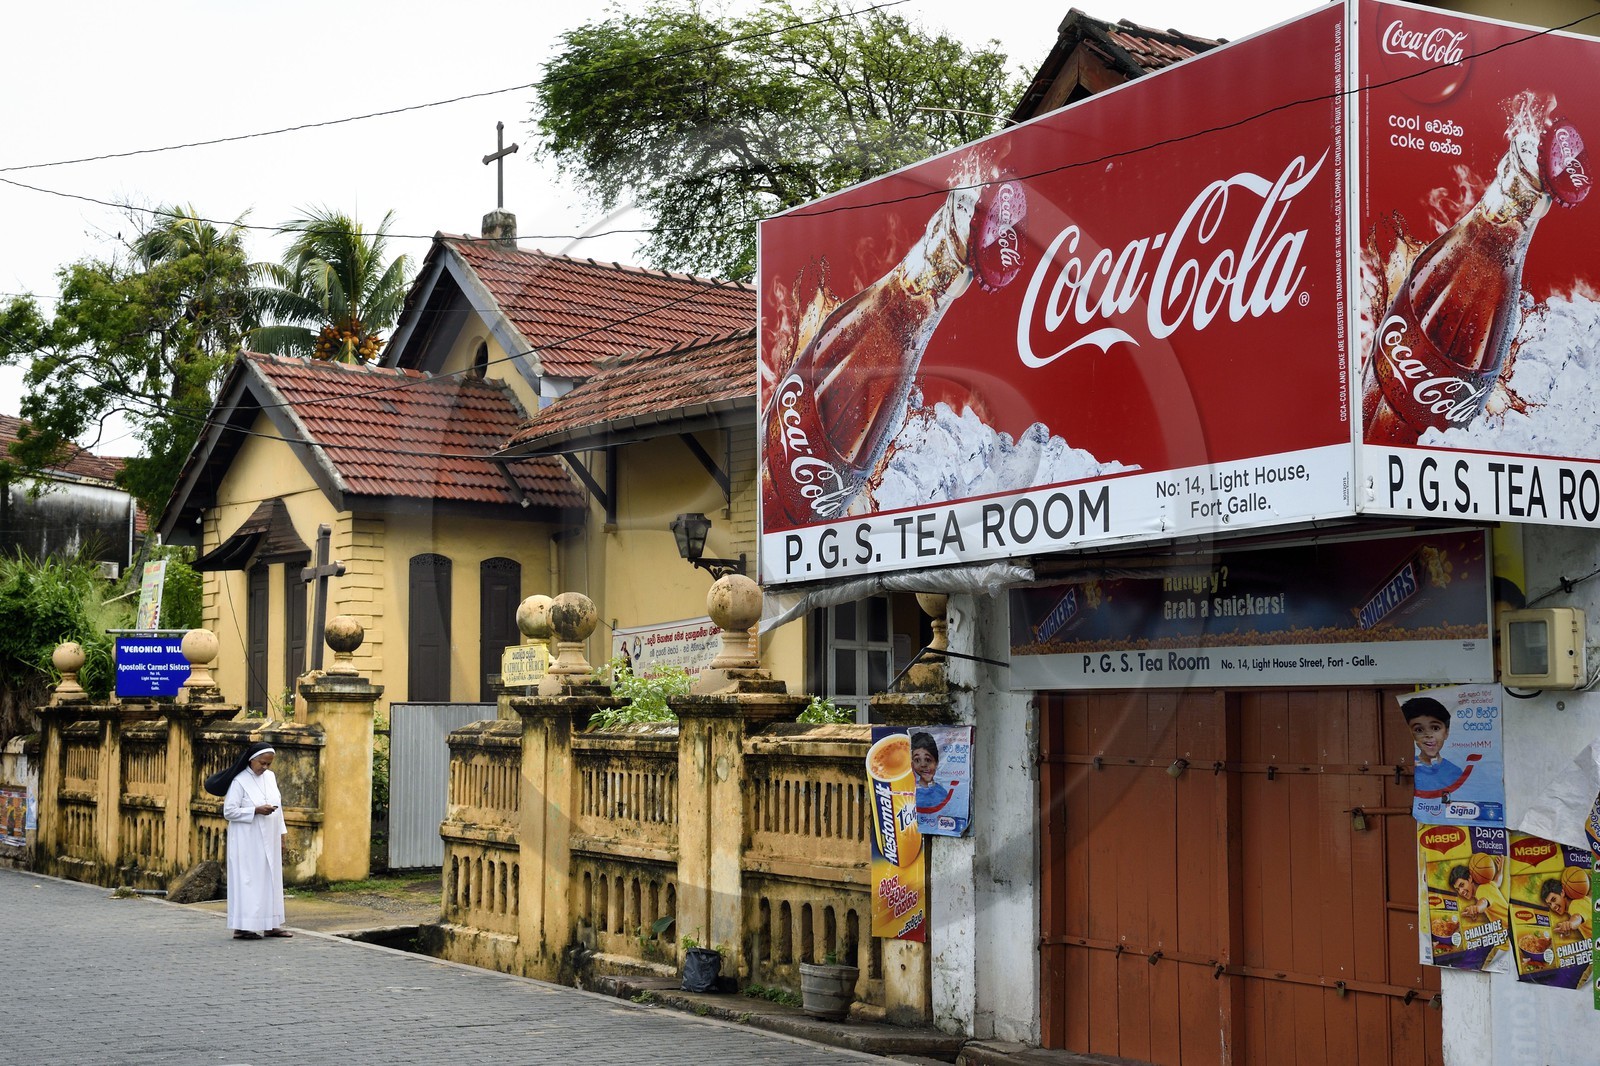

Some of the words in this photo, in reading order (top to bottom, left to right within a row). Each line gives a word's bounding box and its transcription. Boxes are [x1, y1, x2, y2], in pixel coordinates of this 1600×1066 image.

[1382, 20, 1468, 66] Coca-Cola
[1389, 115, 1420, 131] cool
[1425, 119, 1464, 137] වෙන්න
[1390, 133, 1424, 150] coke
[1430, 137, 1463, 156] ගන්න
[1556, 128, 1588, 188] Coca-Cola
[998, 183, 1020, 268] Coca-Cola
[1017, 146, 1330, 369] Coca-Cola
[1379, 315, 1486, 422] Coca-Cola
[777, 374, 852, 516] Coca-Cola
[1156, 480, 1180, 498] No:
[1185, 478, 1205, 496] 14,
[1210, 469, 1249, 492] Light
[1255, 465, 1310, 484] House,
[1488, 462, 1547, 518] TEA
[1191, 501, 1222, 519] Fort
[1228, 496, 1271, 515] Galle.
[894, 510, 965, 560] TEA
[983, 486, 1110, 548] ROOM
[1164, 598, 1196, 620] Grab
[1201, 600, 1209, 617] a
[1360, 566, 1416, 630] SNICKERS
[1038, 592, 1077, 644] SNICKERS
[118, 664, 146, 672] Apostolic
[1138, 653, 1162, 672] Tea
[1168, 652, 1210, 670] Room
[1221, 659, 1235, 669] No.
[1237, 659, 1250, 670] 14,
[1252, 658, 1270, 670] Light
[1272, 658, 1297, 669] House
[1299, 657, 1325, 670] Street,
[1327, 657, 1343, 668] Fort
[1352, 656, 1378, 667] Galle.
[1418, 802, 1440, 812] Signal
[1450, 805, 1476, 816] Signal
[876, 784, 898, 863] Nestomalt
[940, 818, 954, 828] Signal
[1476, 827, 1504, 840] Daiya
[1477, 840, 1503, 850] Chicken
[1464, 920, 1502, 940] CHALLENGE
